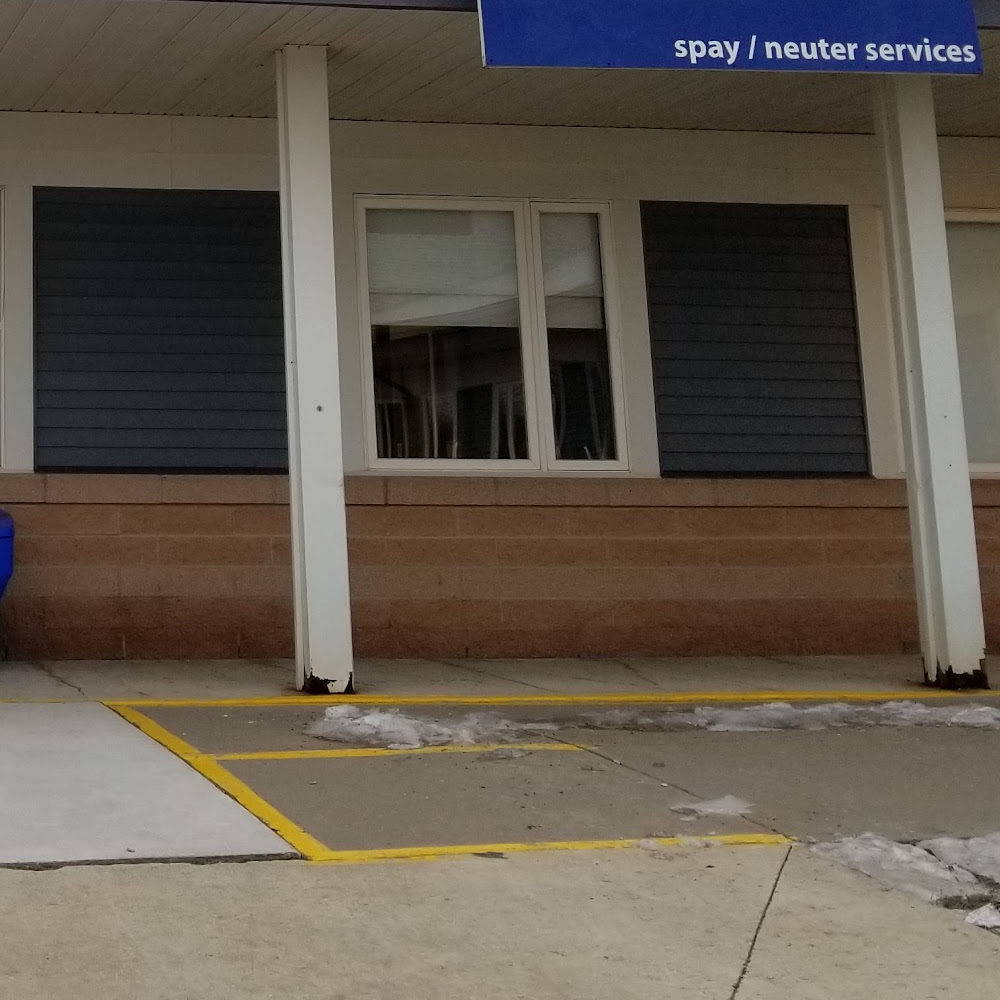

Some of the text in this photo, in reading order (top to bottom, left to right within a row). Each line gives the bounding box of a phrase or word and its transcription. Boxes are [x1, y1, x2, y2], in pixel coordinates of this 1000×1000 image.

[675, 39, 739, 64] spay
[765, 39, 857, 61] neuter
[866, 38, 975, 62] services
